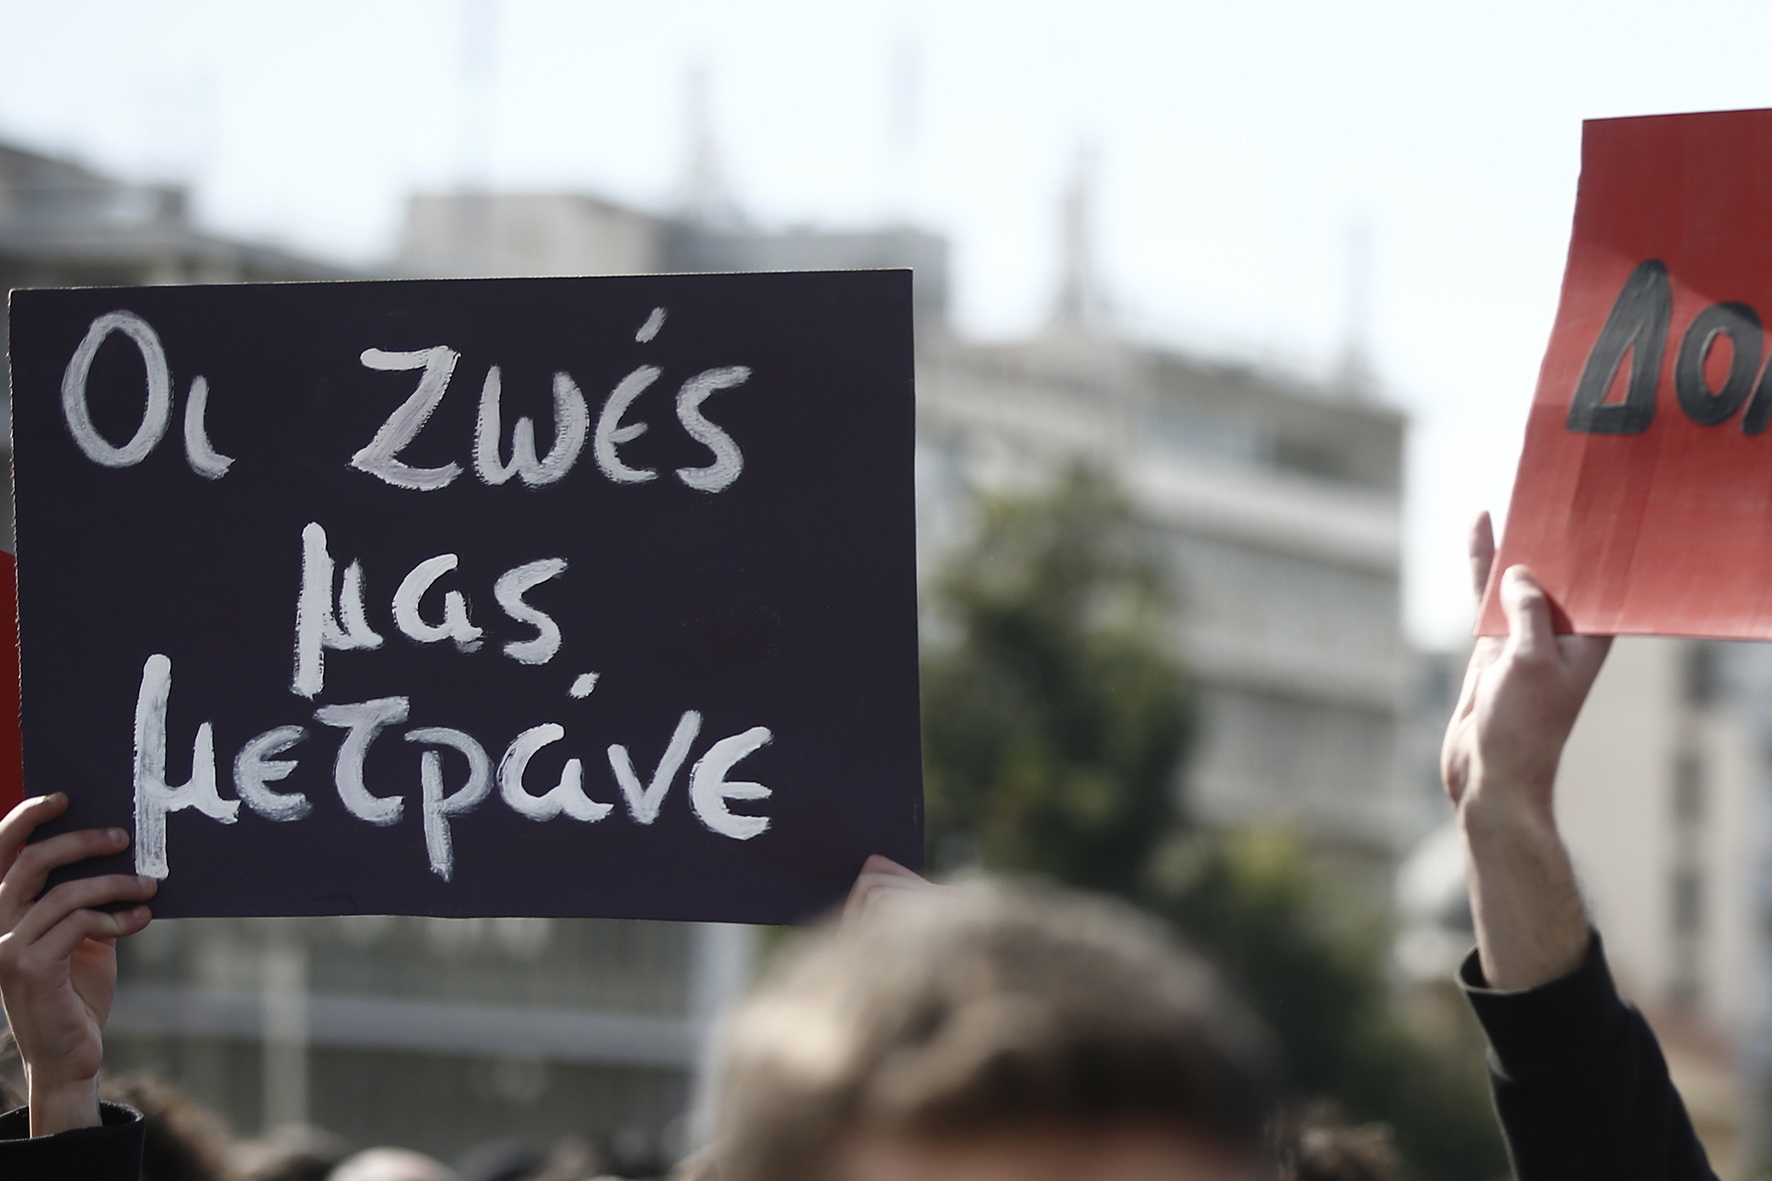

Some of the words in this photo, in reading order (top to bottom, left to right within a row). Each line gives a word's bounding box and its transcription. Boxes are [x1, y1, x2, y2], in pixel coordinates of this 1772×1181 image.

[62, 309, 236, 480] Οι
[349, 306, 754, 494] Ζωές
[291, 521, 570, 699] μας
[133, 654, 776, 882] μετράνε
